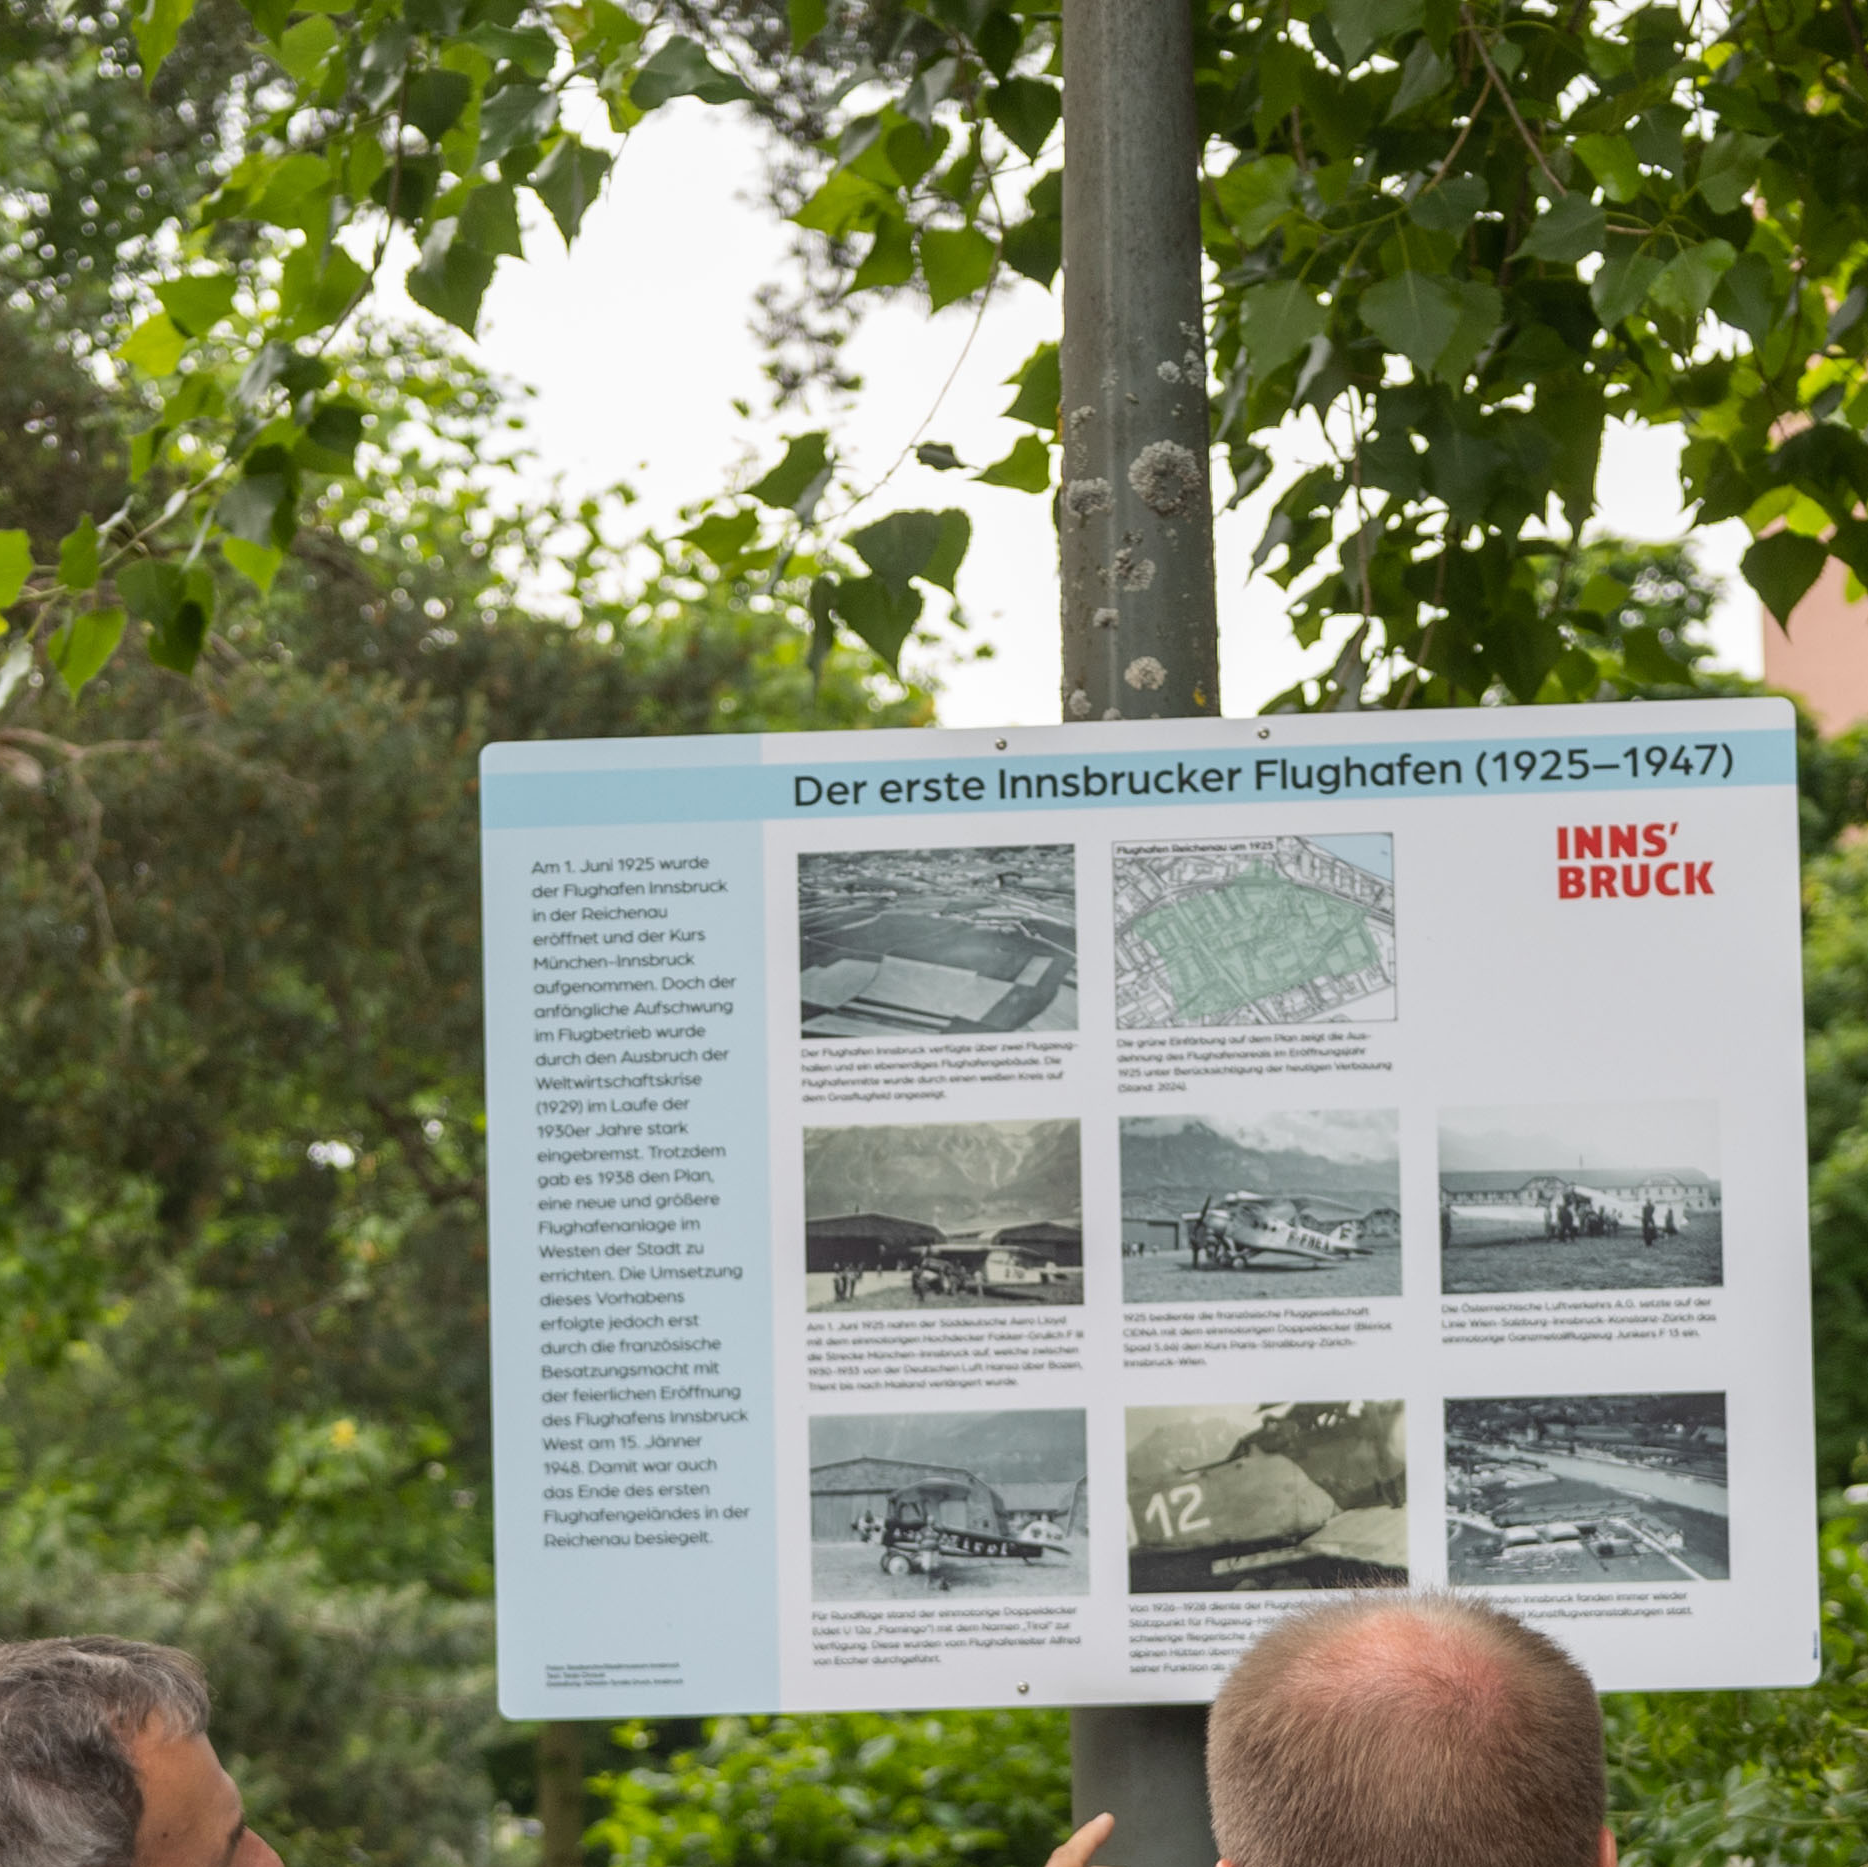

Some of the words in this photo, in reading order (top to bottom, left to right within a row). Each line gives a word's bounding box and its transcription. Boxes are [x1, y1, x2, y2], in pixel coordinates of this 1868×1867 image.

[794, 775, 868, 808] Der
[879, 771, 986, 805] erste
[999, 761, 1242, 801] Innsbrucker
[1255, 752, 1462, 796] Flughafen
[1116, 845, 1169, 855] Flughafen
[1231, 843, 1247, 851] um
[531, 860, 560, 875] Am
[564, 859, 575, 873] 1.
[580, 858, 613, 874] Juni
[618, 857, 655, 872] 1925
[659, 855, 710, 871] wurde
[531, 885, 559, 899] der
[563, 881, 645, 900] Flughafen
[649, 879, 728, 895] Innsbruck
[1558, 861, 1715, 899] BRUCK
[532, 908, 546, 923] in
[549, 907, 577, 923] der
[581, 906, 668, 921] Reichenau
[533, 931, 599, 947] eröffnet
[602, 930, 634, 945] und
[637, 929, 666, 944] der
[669, 928, 706, 943] Kurs
[533, 979, 657, 997] aufgenommen.
[662, 975, 705, 991] Doch
[709, 975, 736, 990] der
[534, 1002, 630, 1021] anfängliche
[633, 999, 733, 1016] Aufschwung
[534, 1029, 554, 1043] im
[558, 1025, 652, 1045] Flugbetrieb
[655, 1023, 706, 1039] wurde
[535, 1051, 581, 1068] durch
[585, 1051, 617, 1067] den
[620, 1048, 698, 1065] Ausbruch
[701, 1048, 729, 1062] der
[535, 1072, 702, 1091] Weltwirtschaftskrise
[536, 1099, 583, 1116] (1929)
[587, 1099, 607, 1114] im
[610, 1097, 658, 1114] Laufe
[661, 1096, 690, 1112] der
[537, 1123, 591, 1140] 1930er
[596, 1123, 643, 1138] Jahre
[647, 1121, 689, 1137] stark
[537, 1147, 643, 1165] eingebremst.
[648, 1144, 726, 1160] Trotzdem
[537, 1172, 570, 1190] gab
[574, 1174, 593, 1187] es
[598, 1169, 635, 1186] 1938
[638, 1170, 670, 1185] den
[674, 1168, 714, 1184] Plan,
[537, 1197, 572, 1212] eine
[576, 1198, 617, 1211] neue
[620, 1194, 652, 1210] und
[655, 1192, 720, 1211] größere
[538, 1218, 676, 1237] Flughafenanlage
[680, 1217, 701, 1232] im
[539, 1245, 601, 1259] Westen
[604, 1243, 632, 1258] der
[636, 1241, 681, 1257] Stadt
[686, 1243, 704, 1257] zu
[539, 1268, 615, 1284] errichten.
[619, 1266, 646, 1282] Die
[650, 1265, 743, 1281] Umsetzung
[540, 1293, 592, 1308] dieses
[596, 1290, 685, 1306] Vorhabens
[539, 1315, 605, 1334] erfolgte
[608, 1314, 664, 1332] jedoch
[667, 1314, 699, 1328] erst
[540, 1340, 587, 1357] durch
[590, 1339, 616, 1354] die
[619, 1337, 722, 1354] französische
[541, 1361, 689, 1381] Besatzungsmacht
[693, 1360, 719, 1375] mit
[541, 1389, 569, 1404] der
[572, 1386, 656, 1403] feierlichen
[659, 1384, 741, 1401] Eröffnung
[541, 1414, 572, 1429] des
[575, 1410, 666, 1429] Flughafens
[669, 1408, 748, 1425] Innsbruck
[542, 1437, 583, 1452] West
[587, 1438, 615, 1451] am
[619, 1434, 640, 1450] 15.
[644, 1434, 702, 1450] Jänner
[544, 1460, 584, 1476] 1948.
[588, 1459, 638, 1476] Damit
[642, 1460, 673, 1474] war
[676, 1457, 717, 1474] auch
[542, 1486, 574, 1501] das
[578, 1484, 620, 1500] Ende
[624, 1483, 654, 1499] des
[657, 1483, 710, 1497] ersten
[544, 1506, 701, 1527] Flughafengeländes
[704, 1506, 719, 1520] in
[722, 1505, 750, 1520] der
[1145, 1482, 1211, 1539] 12
[544, 1533, 631, 1548] Reichenau
[634, 1530, 713, 1548] besiegelt.
[1523, 1594, 1572, 1603] Innsbruck
[1576, 1593, 1610, 1602] fanden
[1616, 1592, 1649, 1601] immer
[1653, 1591, 1687, 1600] wieder
[1667, 1606, 1693, 1615] statt.
